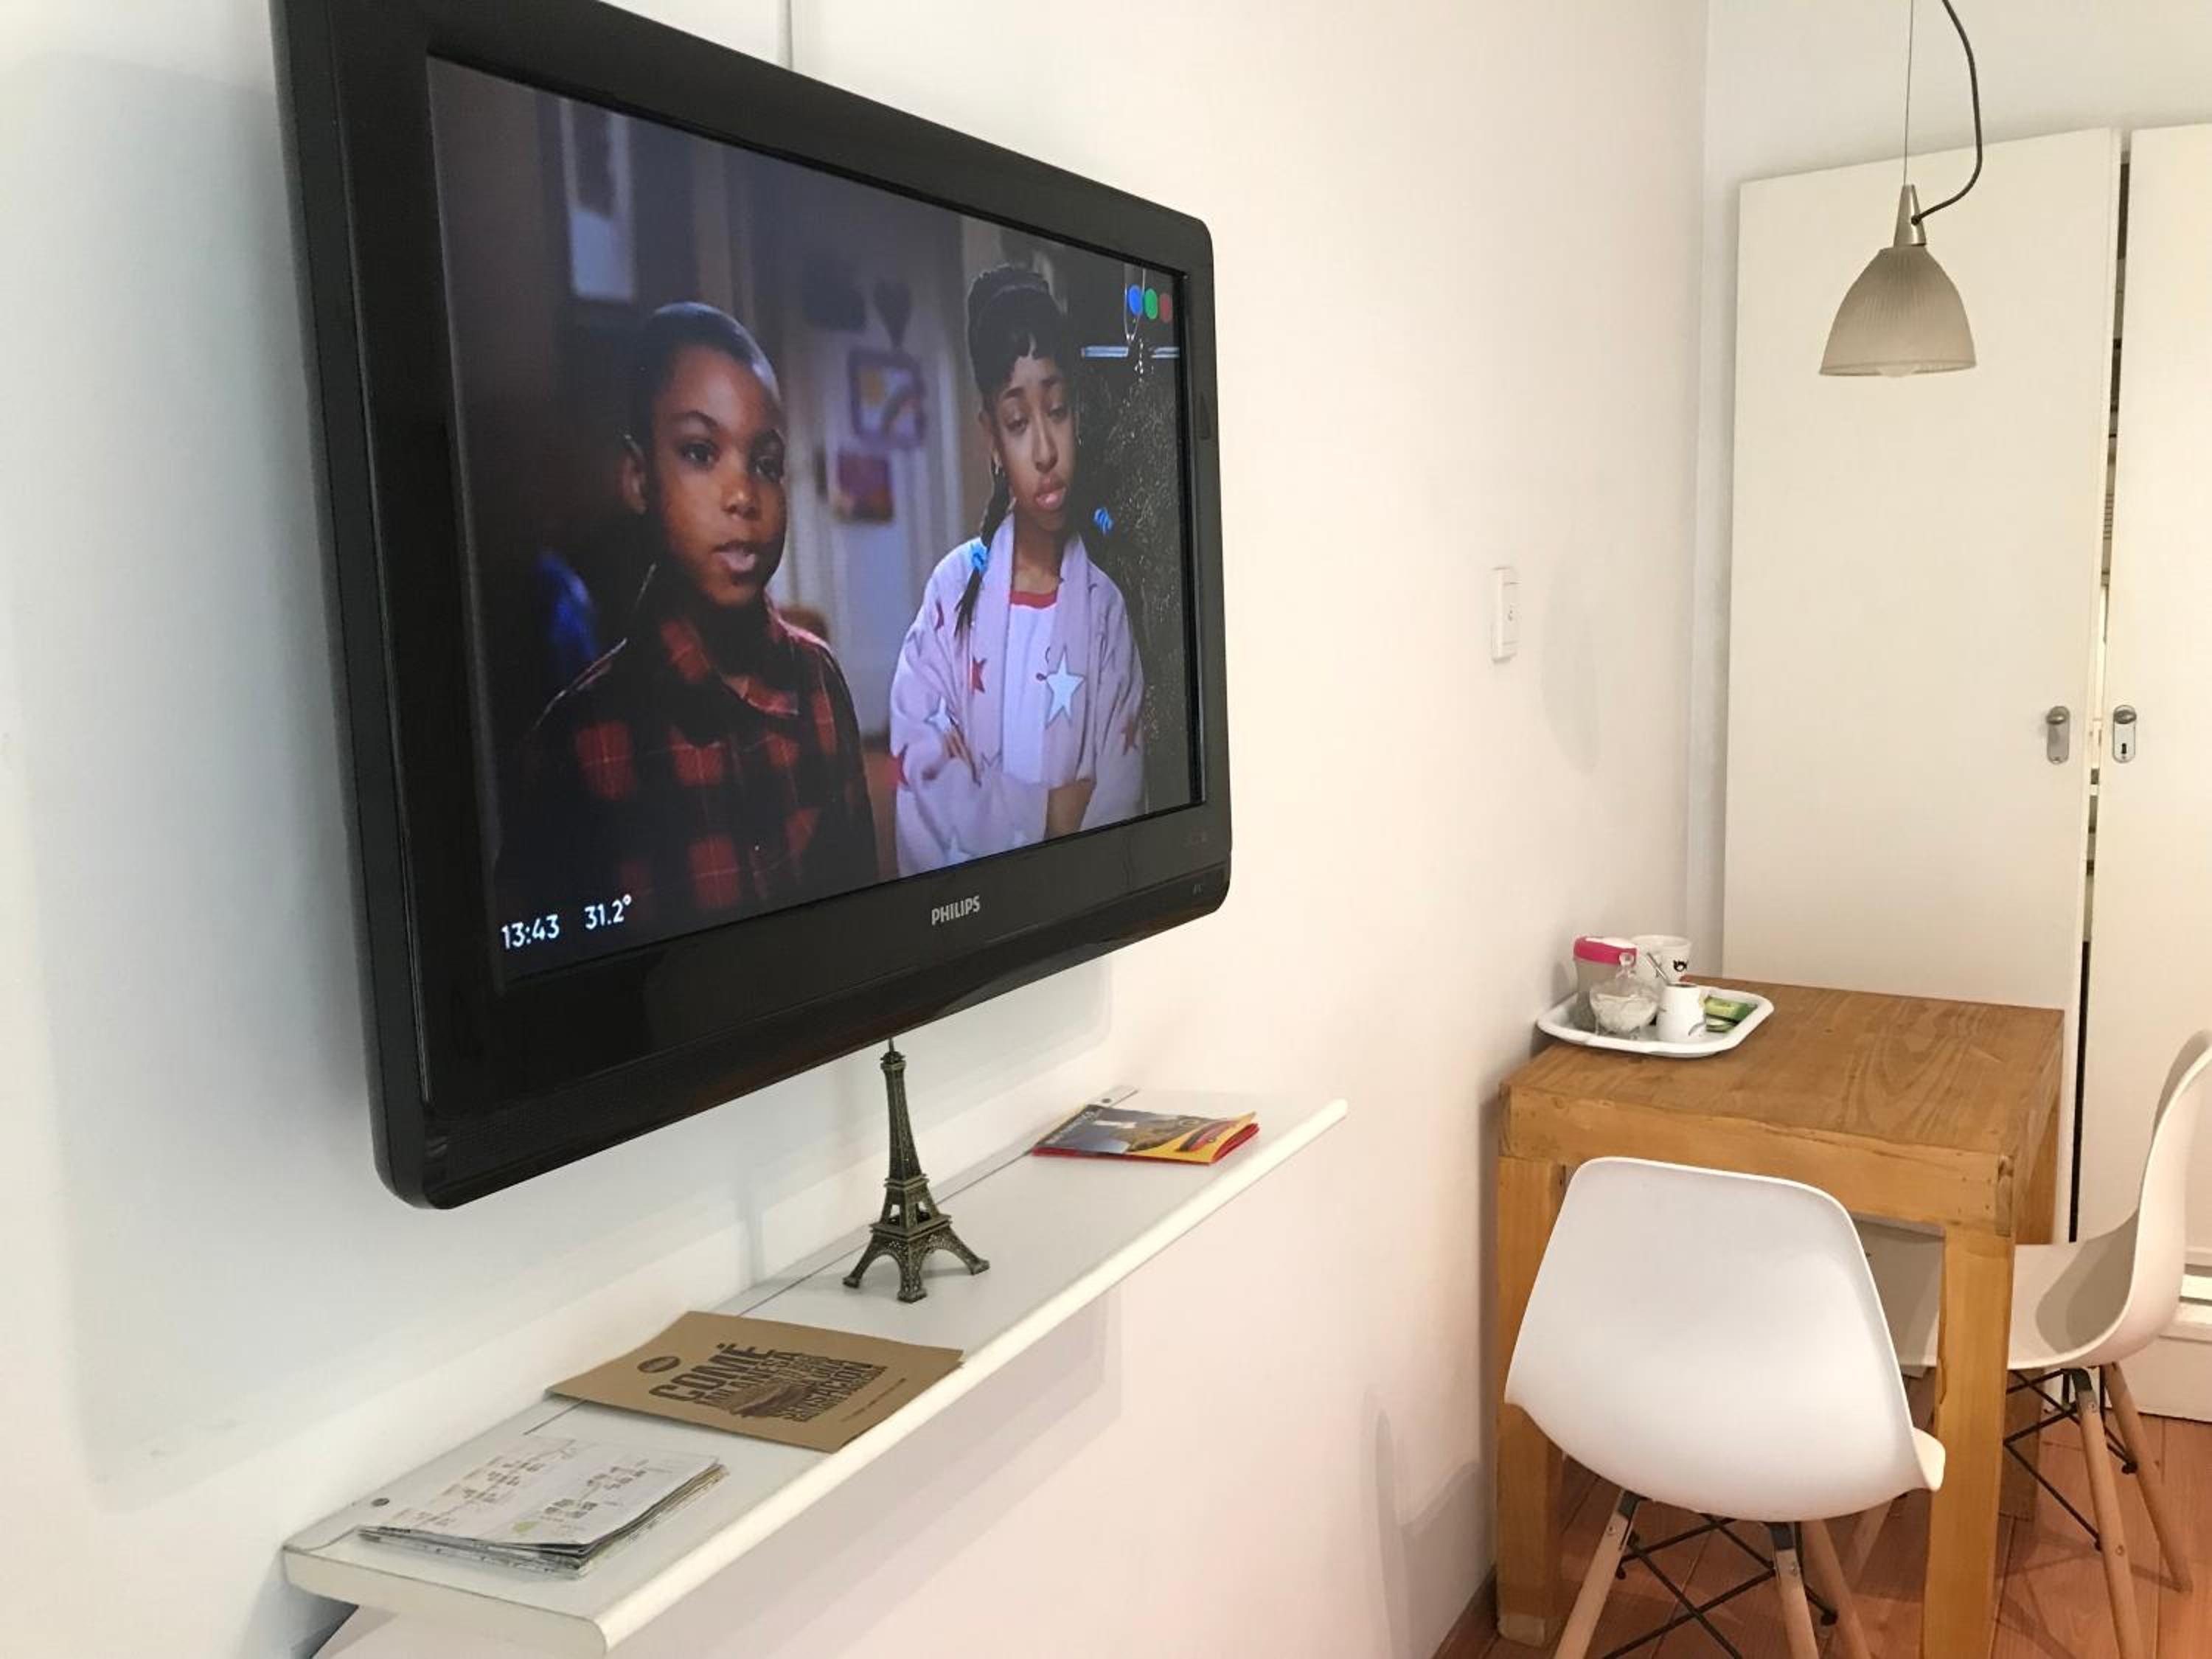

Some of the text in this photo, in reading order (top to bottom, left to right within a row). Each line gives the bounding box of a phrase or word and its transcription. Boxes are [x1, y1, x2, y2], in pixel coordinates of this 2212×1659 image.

[501, 894, 632, 949] 13:43 31.2°
[931, 895, 980, 925] PHILIPS
